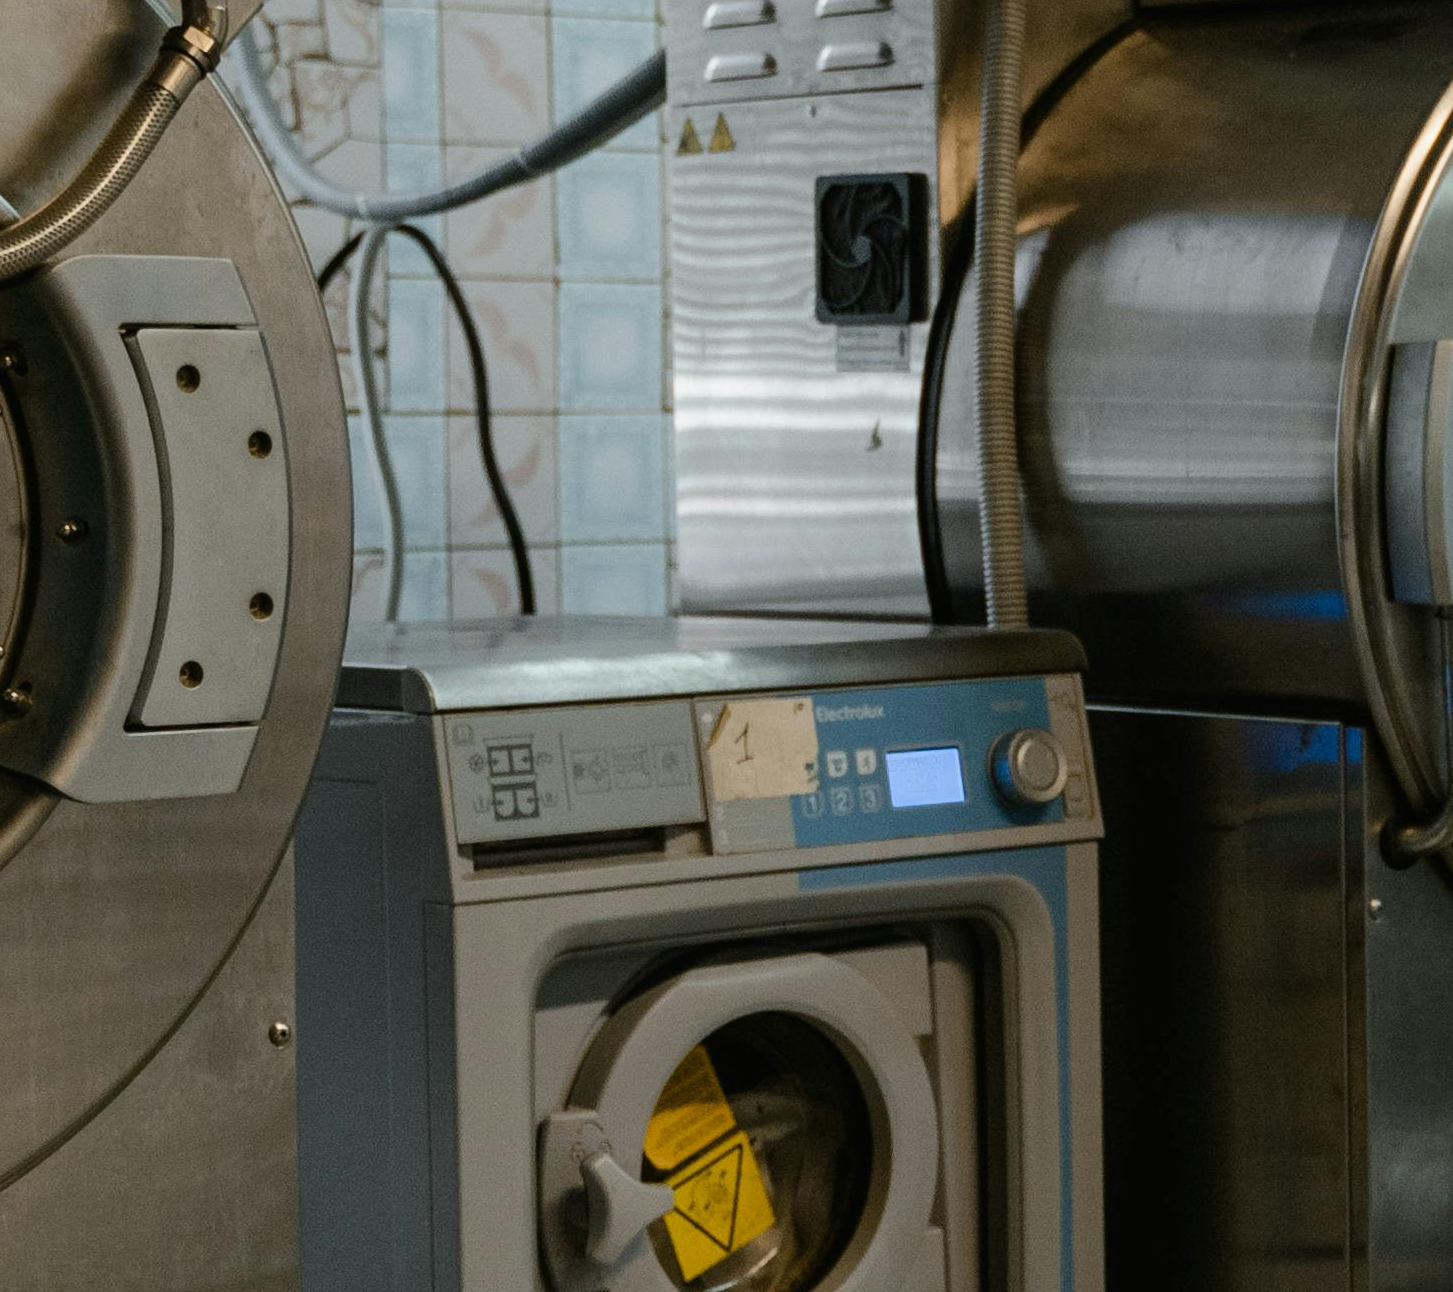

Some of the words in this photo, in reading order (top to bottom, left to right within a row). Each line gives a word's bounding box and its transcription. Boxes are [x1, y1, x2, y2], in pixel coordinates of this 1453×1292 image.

[815, 705, 884, 723] Electrolux
[734, 721, 755, 765] 1
[835, 792, 848, 812] 2
[864, 789, 877, 809] 3
